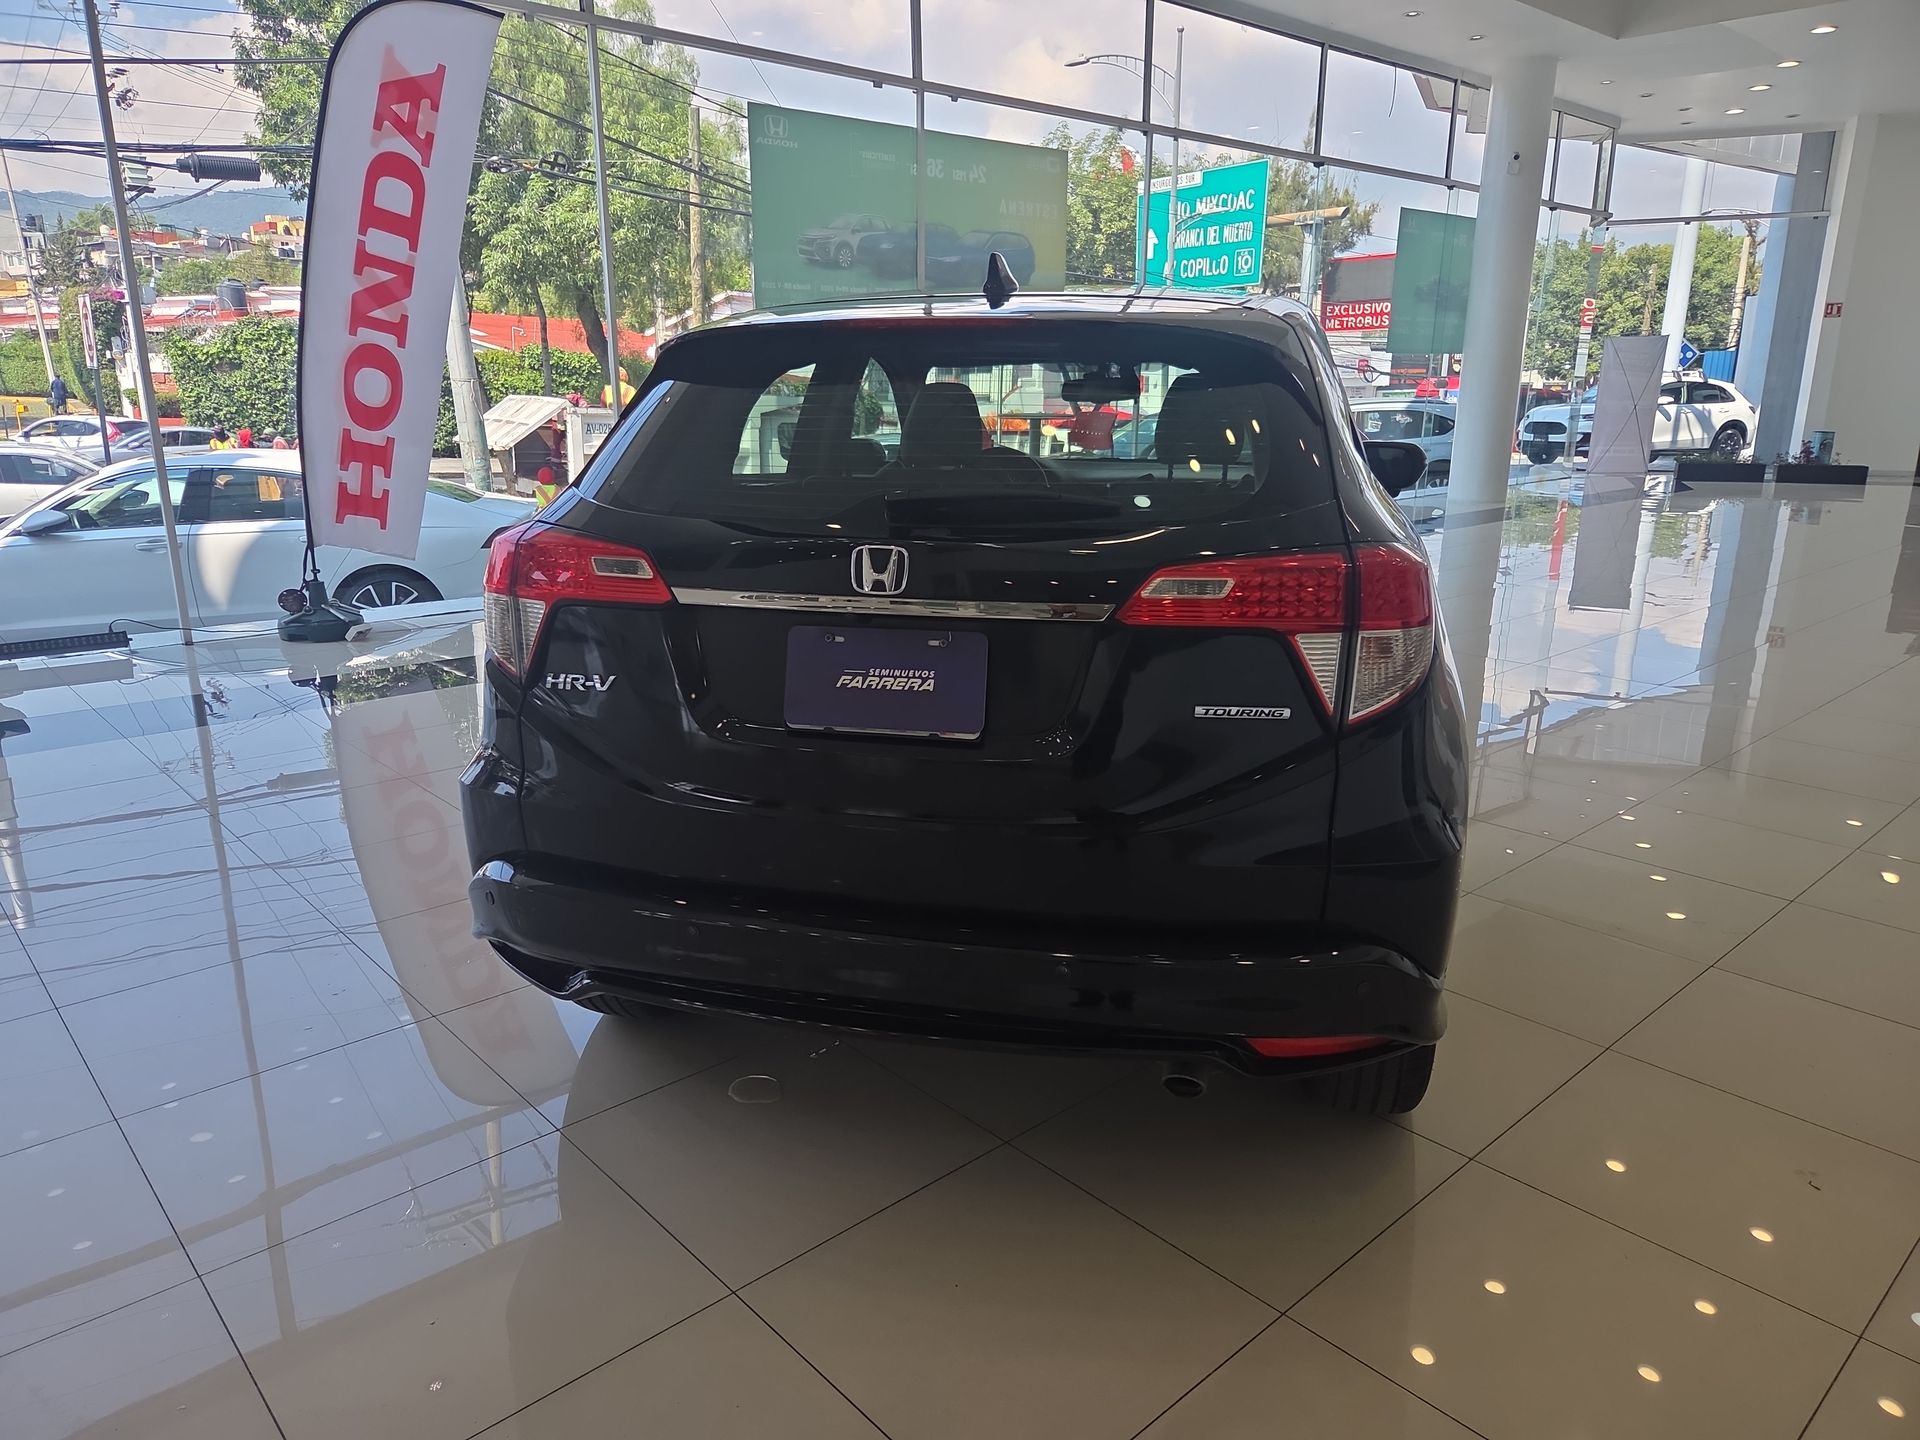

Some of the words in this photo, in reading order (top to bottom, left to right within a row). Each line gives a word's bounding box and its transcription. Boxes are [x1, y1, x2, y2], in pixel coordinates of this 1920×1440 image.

[1207, 225, 1220, 246] DEL
[1223, 221, 1253, 243] MUERTO
[336, 63, 447, 530] HONDA
[1326, 302, 1392, 316] EXCLUSIVO
[1325, 315, 1390, 329] METROBUS
[868, 668, 936, 678] SEMINUEVOS
[545, 672, 617, 691] HR-V
[836, 675, 935, 691] FARRERA
[1201, 707, 1286, 718] TOURING
